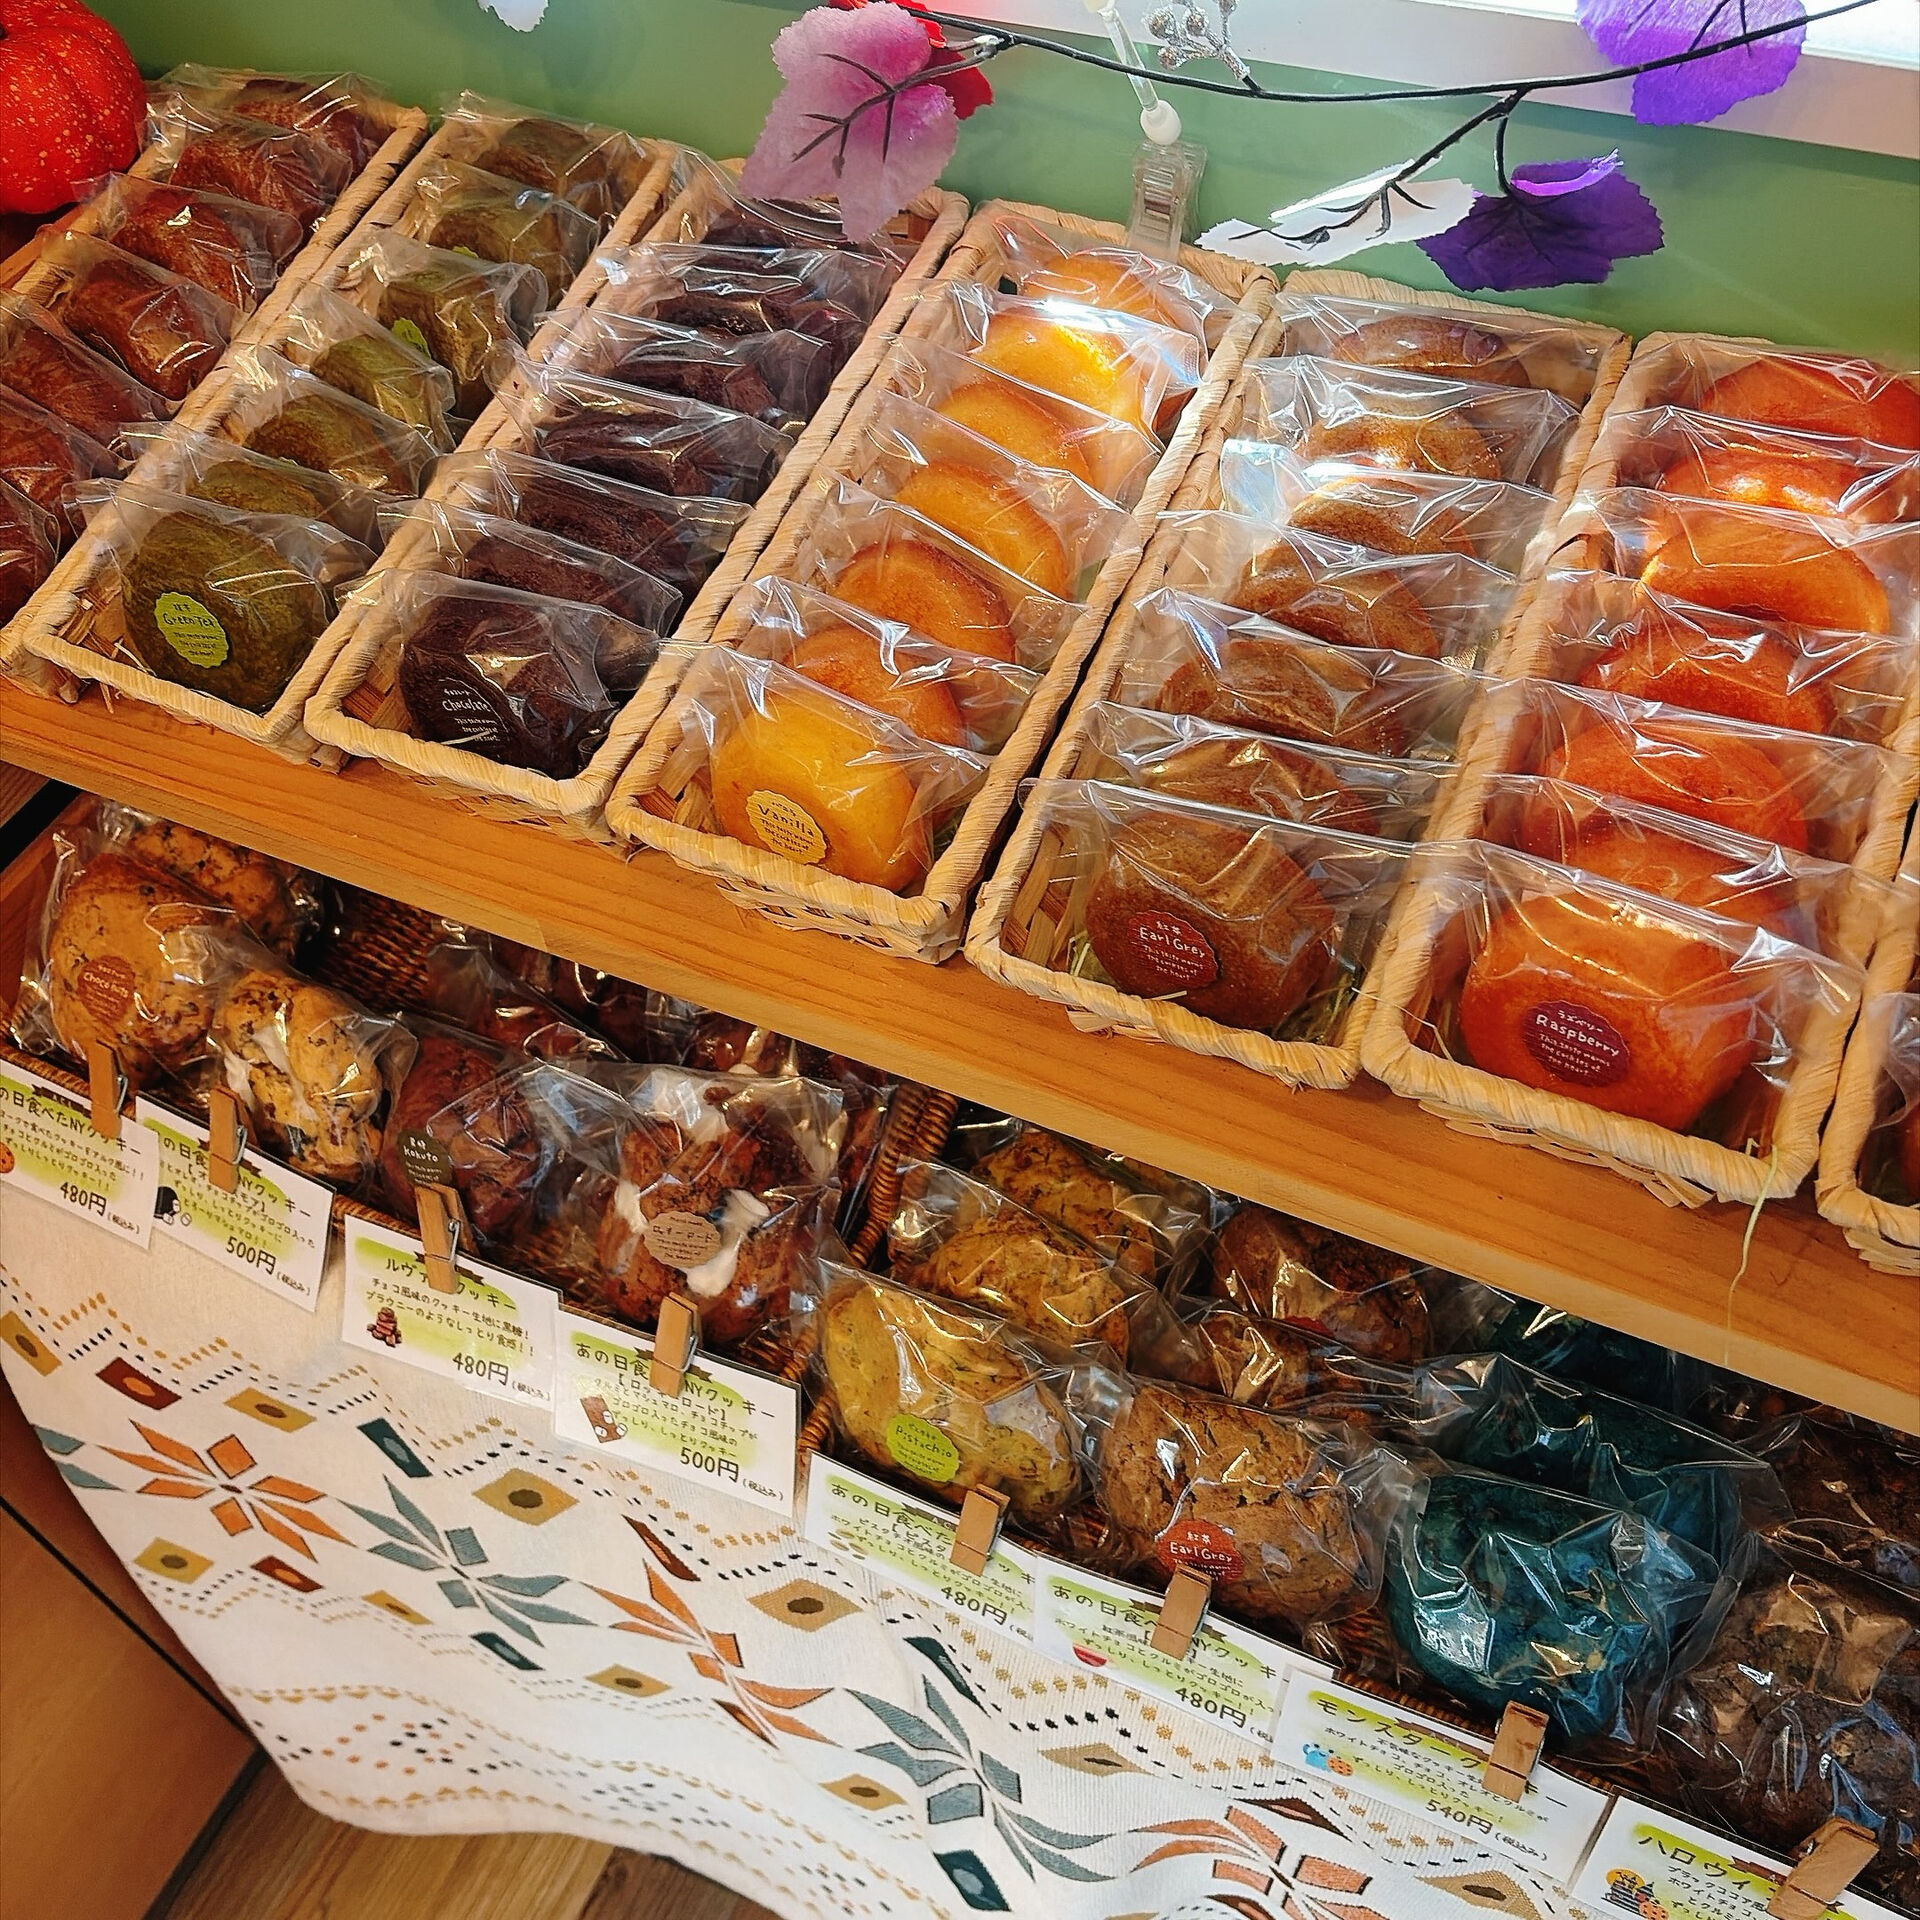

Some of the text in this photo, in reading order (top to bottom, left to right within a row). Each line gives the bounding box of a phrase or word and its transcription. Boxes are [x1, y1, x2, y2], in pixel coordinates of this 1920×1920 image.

[442, 699, 492, 712] Chocolate
[757, 804, 815, 838] Vanilla
[1139, 927, 1206, 958] Earl Grey
[1535, 1014, 1620, 1057] Raspberry
[151, 1128, 311, 1217] の日食NYクッキー
[60, 1181, 107, 1217] 480円
[225, 1236, 277, 1276] 500円
[385, 1258, 516, 1310] ルヴァクッキー
[452, 1352, 509, 1387] 480円
[576, 1343, 776, 1419] あの日食NYクッキー
[680, 1447, 740, 1484] 500円
[1169, 1542, 1198, 1557] Earl
[1201, 1549, 1233, 1563] Grey
[940, 1586, 1008, 1626] 480円
[1174, 1687, 1248, 1729] 480円
[1317, 1699, 1568, 1808] モンスタークキー
[1424, 1799, 1493, 1835] 540円
